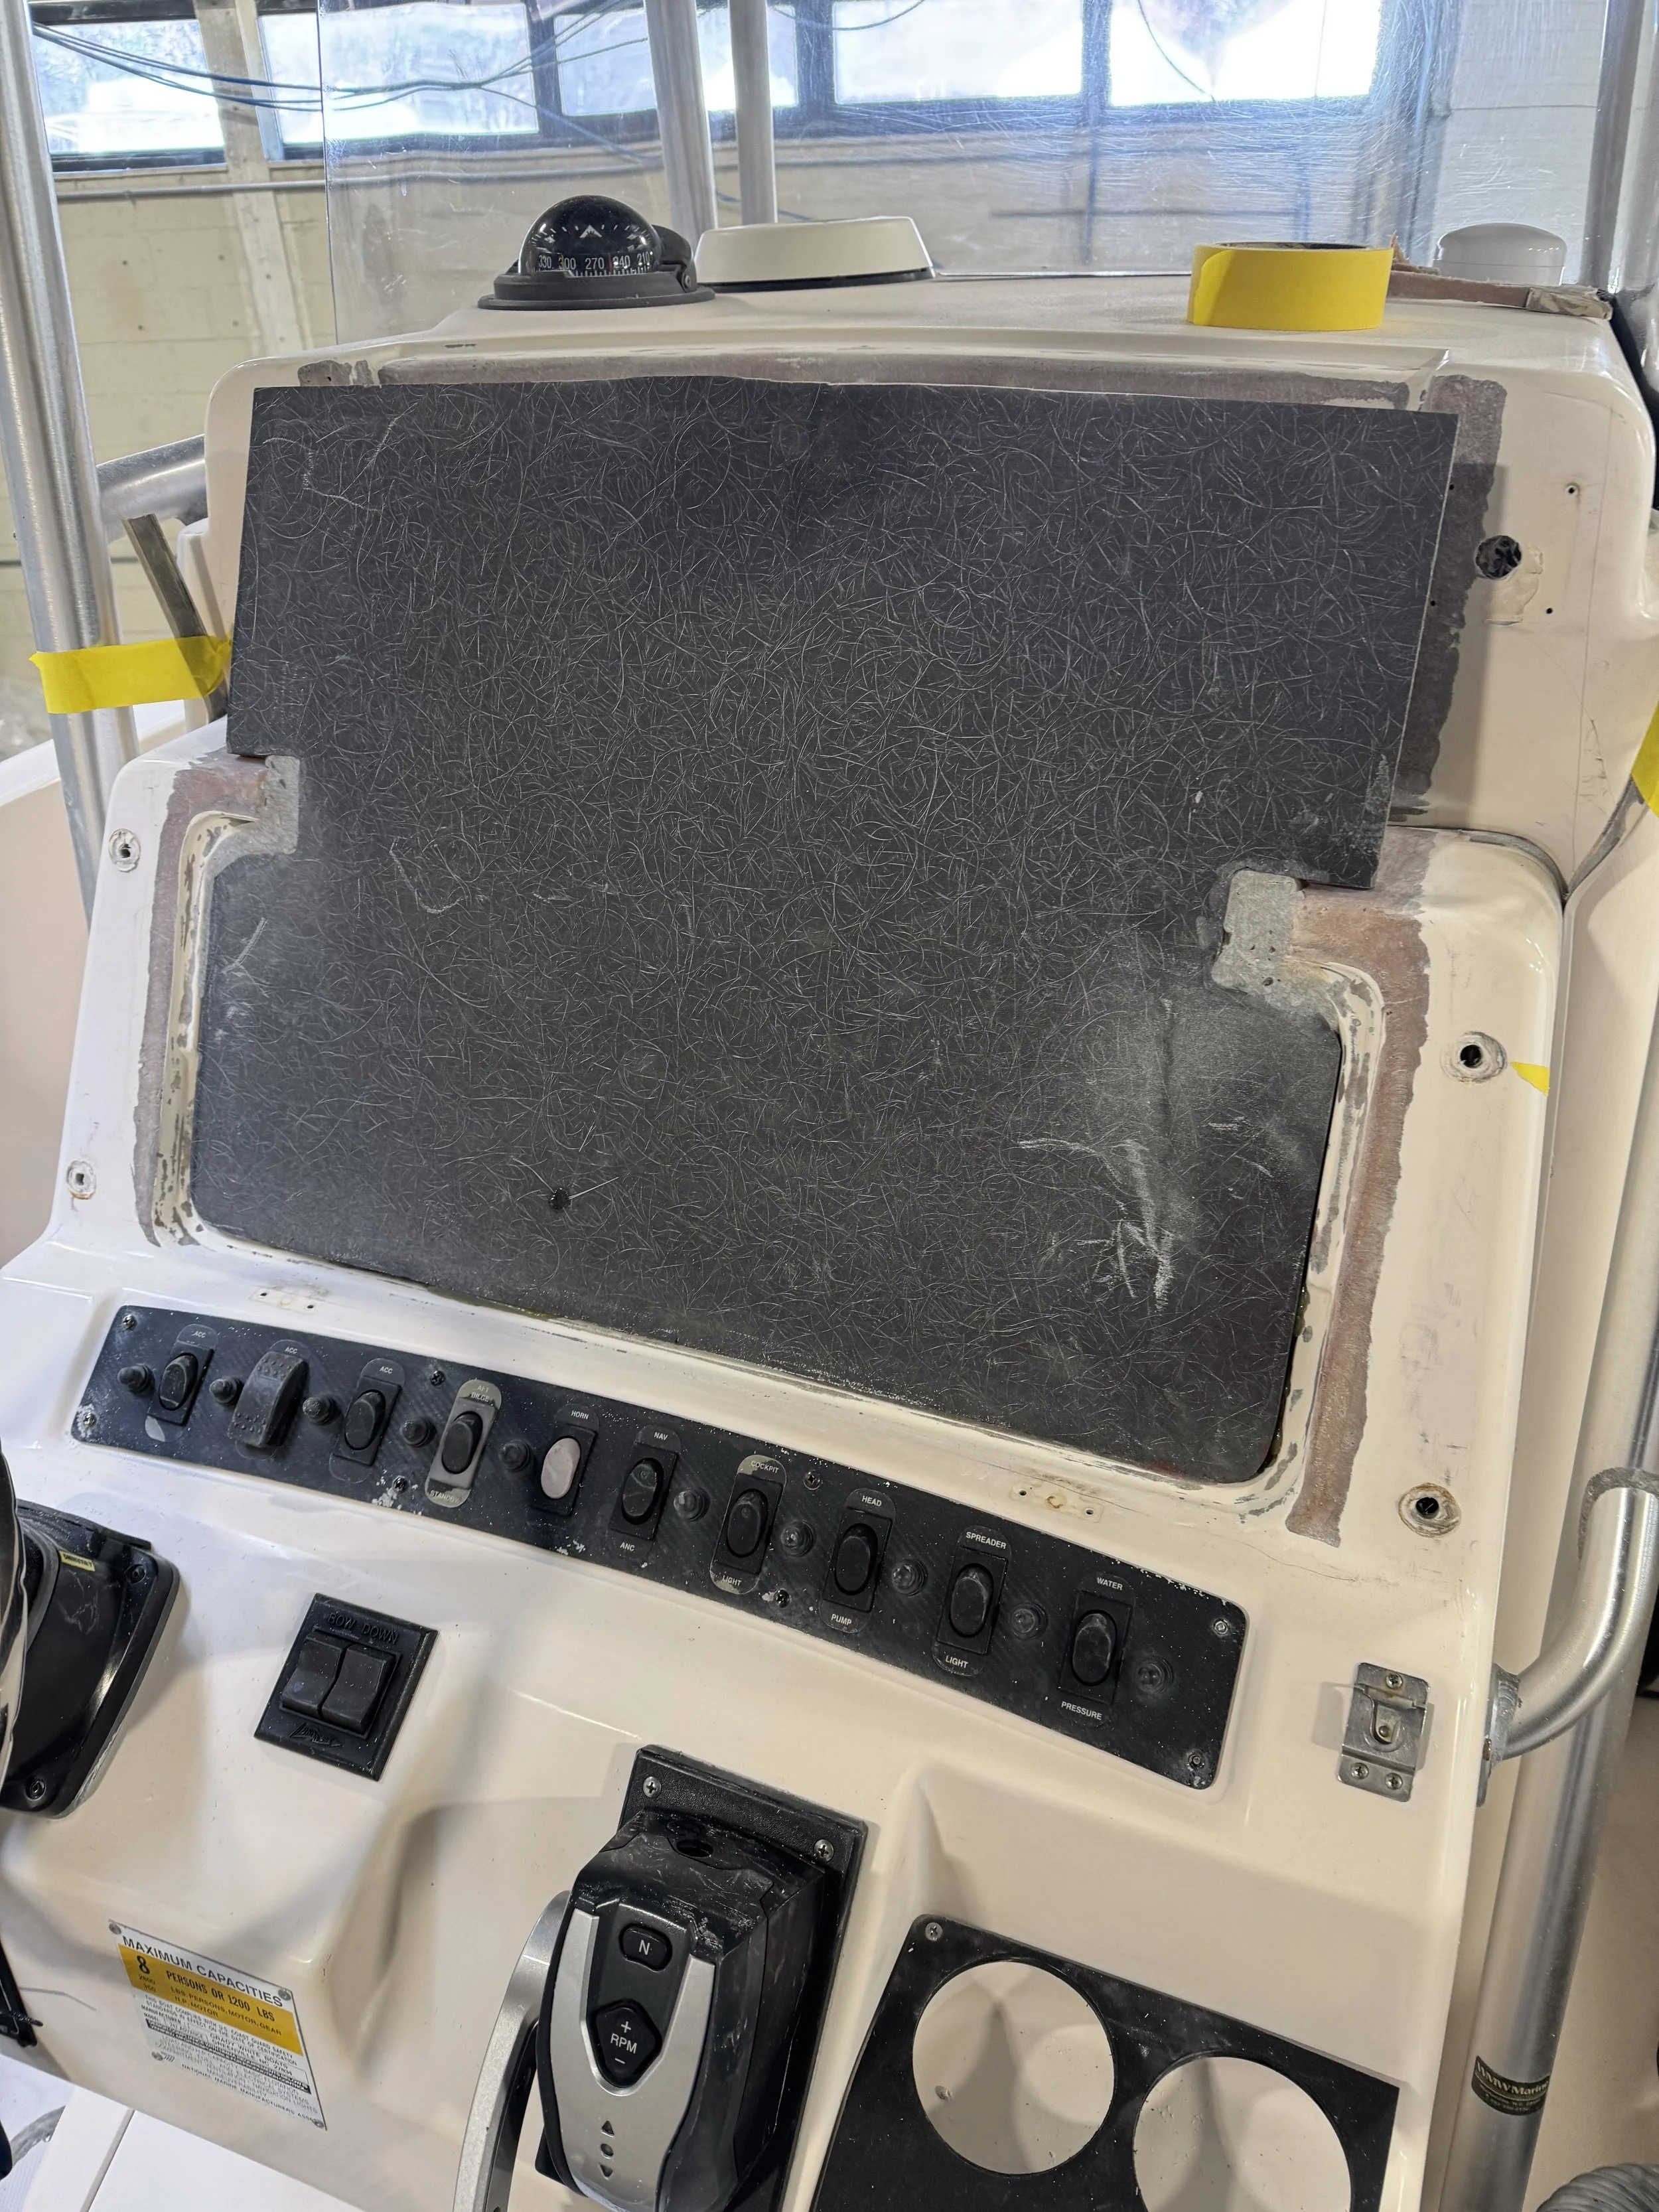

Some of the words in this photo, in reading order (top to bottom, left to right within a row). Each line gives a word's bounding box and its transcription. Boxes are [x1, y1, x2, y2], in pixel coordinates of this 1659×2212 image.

[538, 255, 551, 268] 330
[585, 257, 605, 269] 270
[613, 255, 630, 269] 240
[637, 252, 650, 265] 210
[284, 1346, 298, 1355] ACC
[379, 1366, 393, 1374] ACC
[571, 1410, 589, 1420] HORN
[654, 1432, 669, 1441] NAV
[751, 1460, 780, 1474] COCKPIT
[861, 1495, 882, 1507] HEAD
[620, 1542, 635, 1552] ANC
[966, 1531, 1007, 1550] SPREADER
[721, 1575, 742, 1587] LIGHT
[1096, 1576, 1123, 1591] WATER
[831, 1613, 852, 1626] PUMP
[328, 1612, 356, 1630] BOW
[362, 1623, 399, 1645] DOWN
[945, 1655, 969, 1669] LIGHT
[1061, 1700, 1103, 1721] PRESSURE
[638, 1939, 650, 1956] N
[123, 1936, 192, 1970] MAXIMUM
[196, 1965, 283, 2007] CAPACITIES
[136, 1954, 151, 1975] 8
[166, 1970, 208, 1995] PERSONS
[211, 1988, 224, 2001] OR
[228, 1995, 251, 2012] 1200
[257, 2008, 275, 2022] LBS
[610, 2033, 638, 2055] RPM
